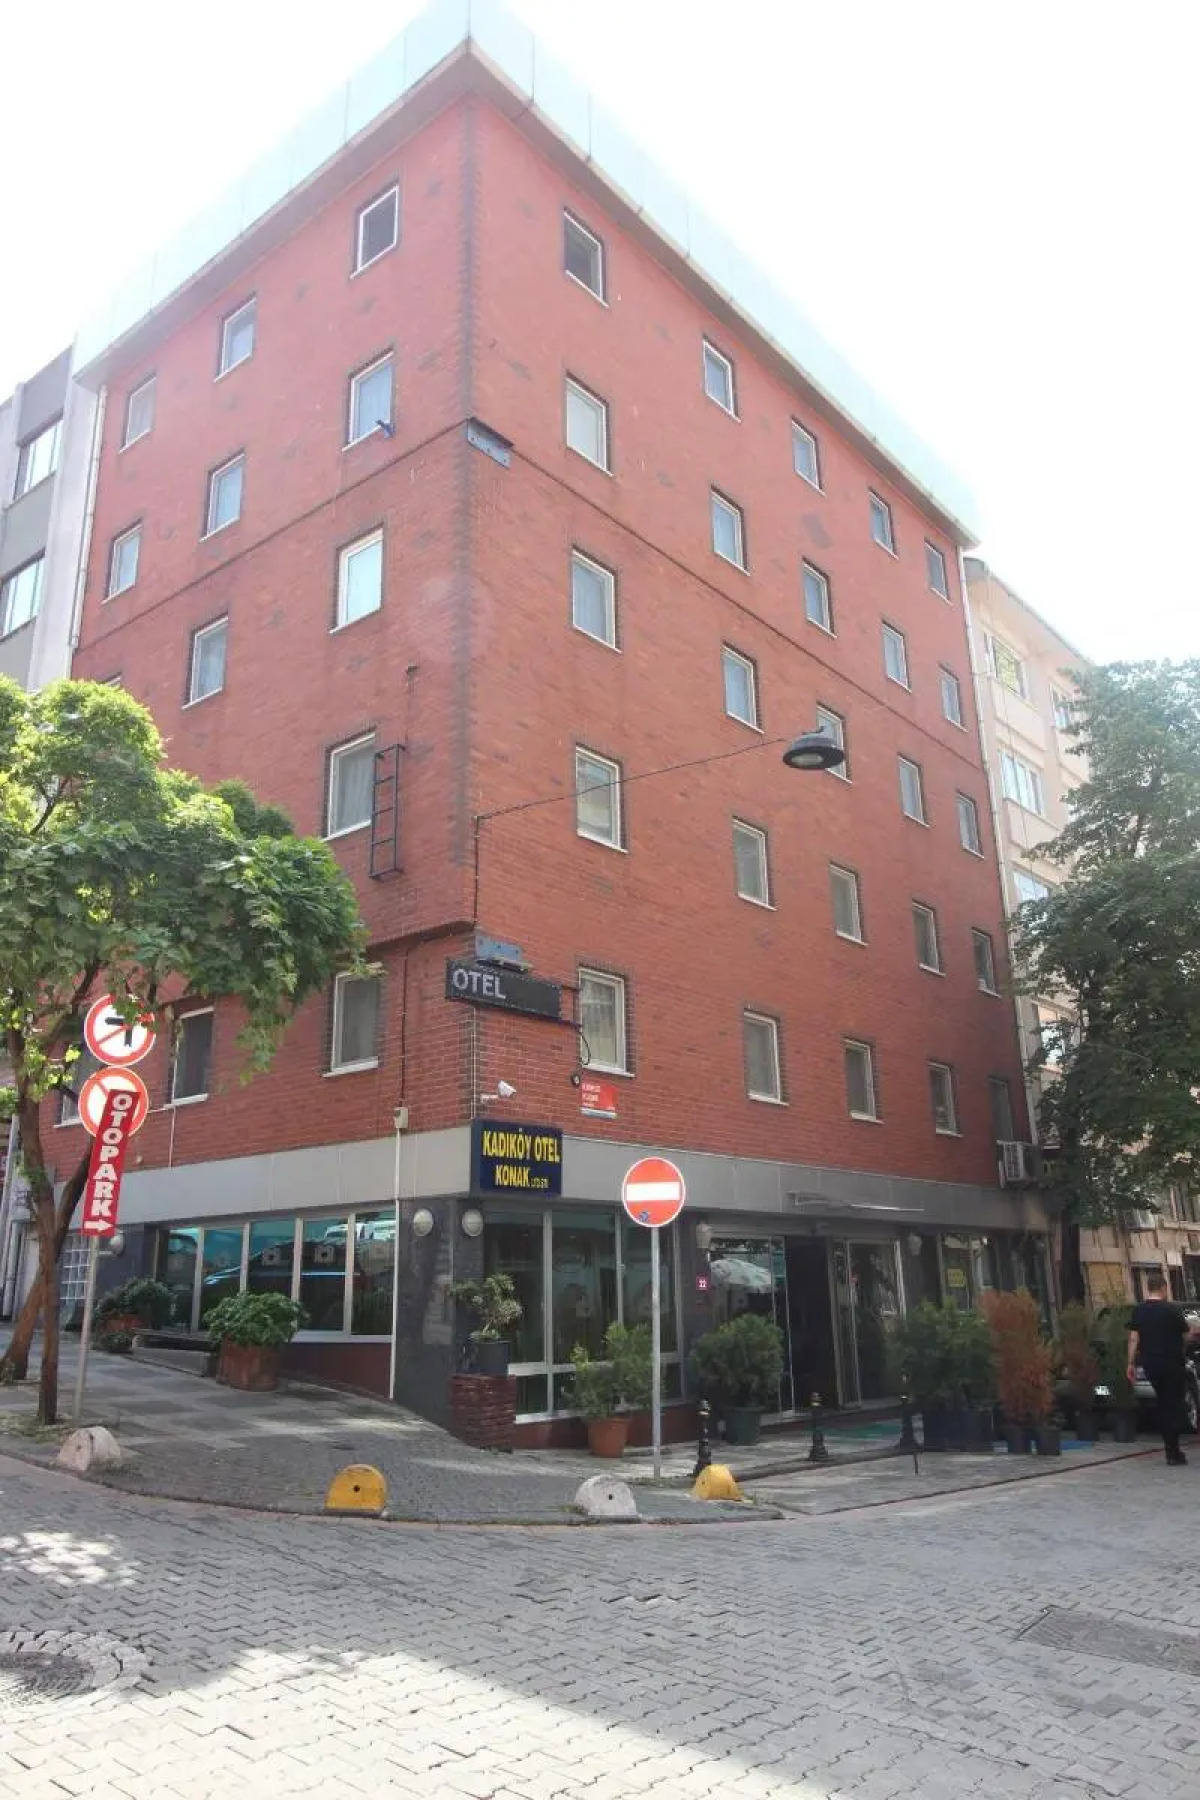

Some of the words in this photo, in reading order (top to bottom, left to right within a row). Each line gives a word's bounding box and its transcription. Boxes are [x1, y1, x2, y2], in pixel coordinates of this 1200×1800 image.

[453, 968, 507, 999] OTEL
[91, 1093, 133, 1217] OTOPARK
[534, 1134, 560, 1163] OTEL
[495, 1164, 531, 1187] KONAK
